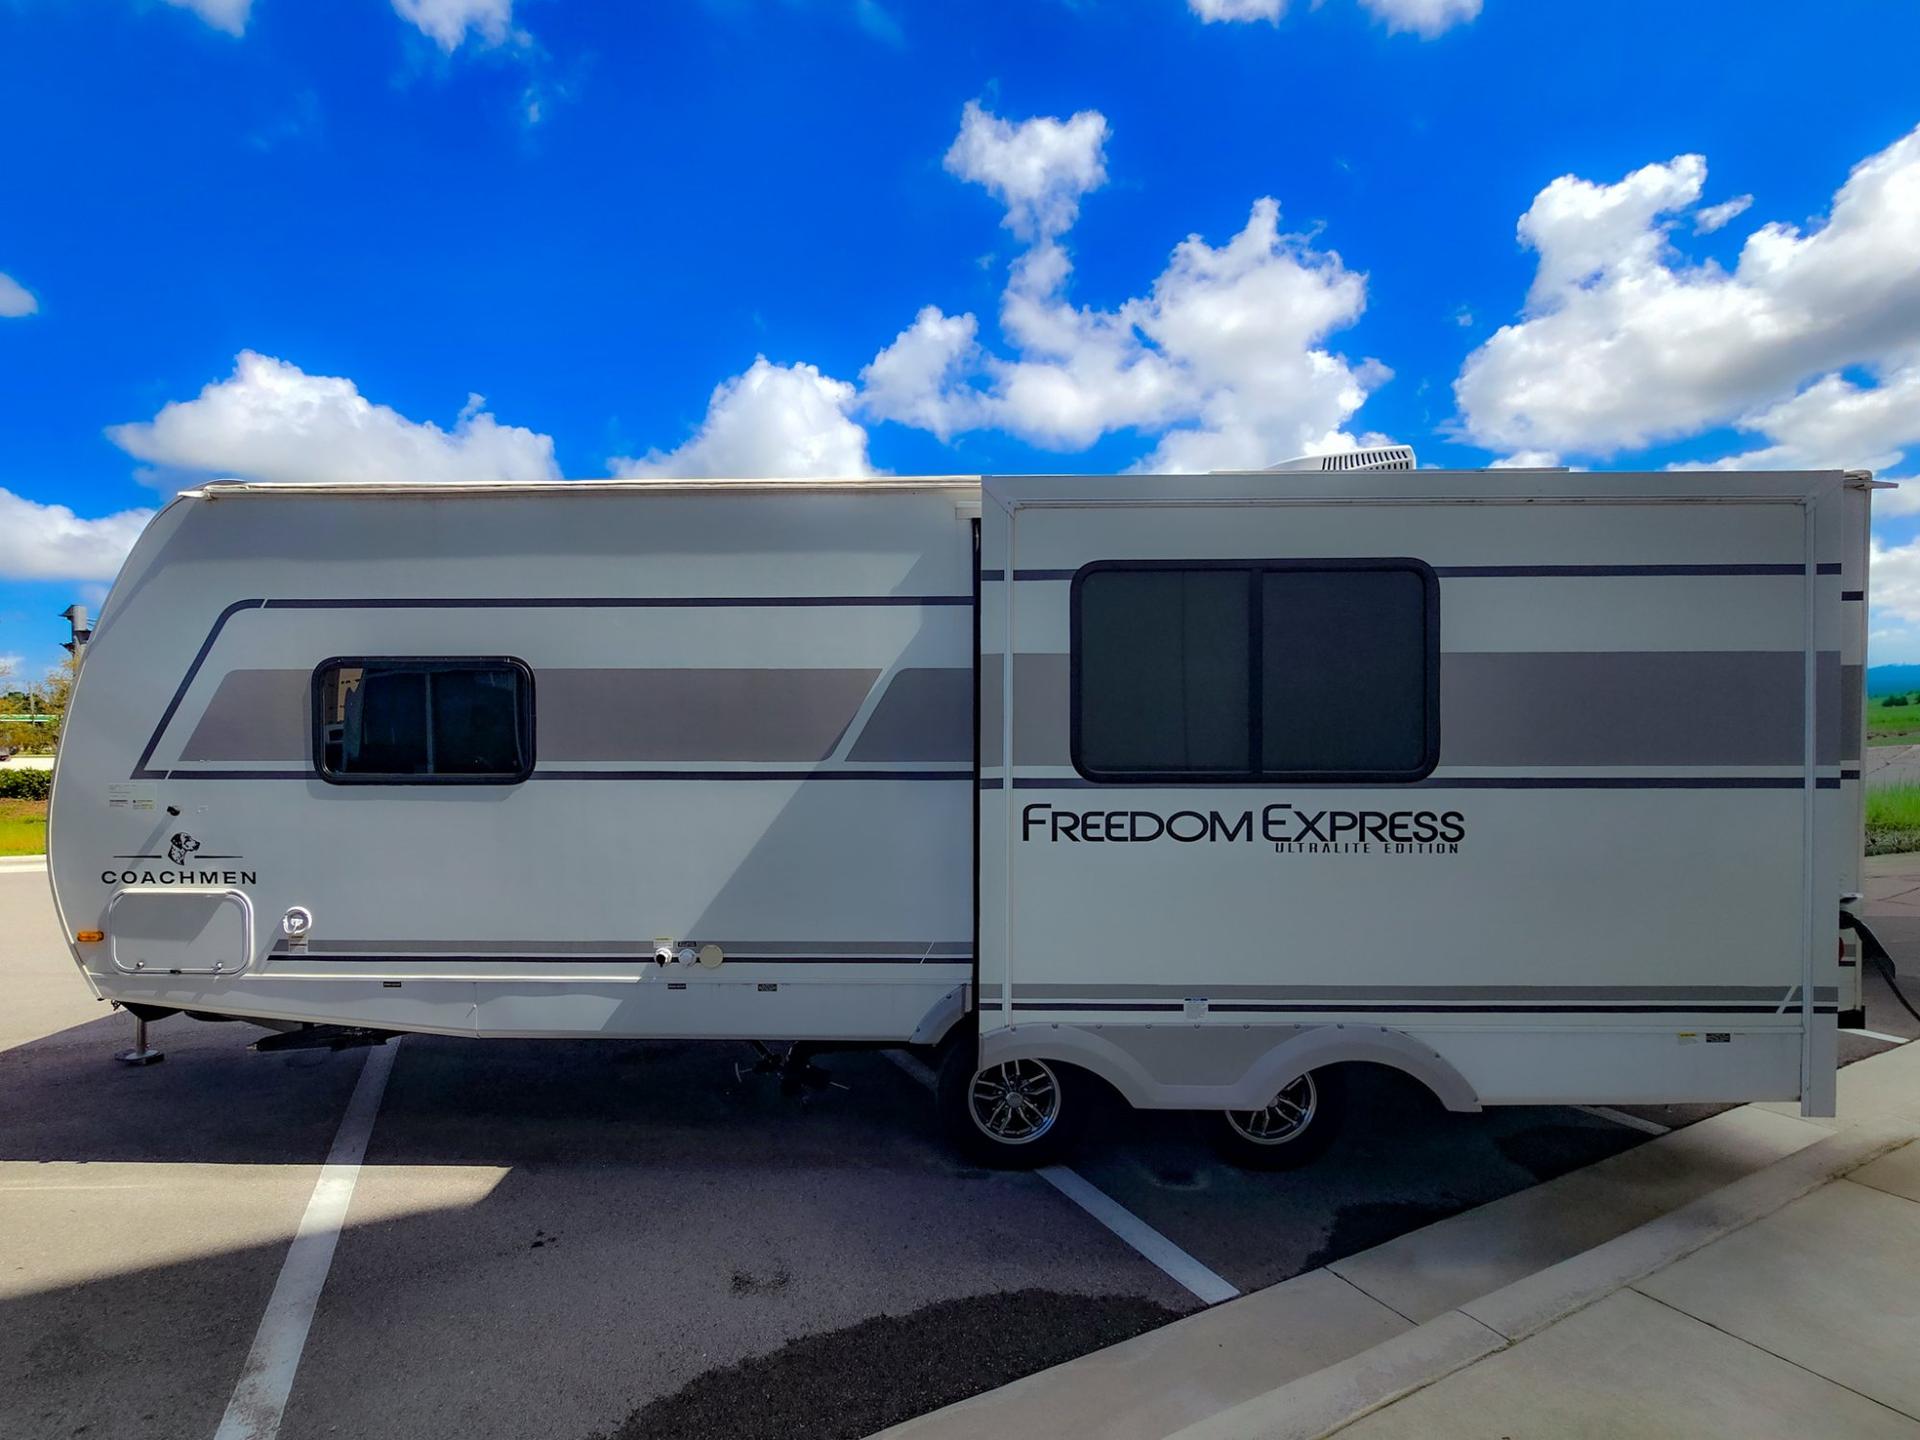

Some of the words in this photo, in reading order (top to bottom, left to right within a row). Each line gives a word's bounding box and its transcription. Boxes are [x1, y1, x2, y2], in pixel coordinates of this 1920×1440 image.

[1022, 803, 1253, 842] FREEDOM
[1262, 803, 1465, 842] EXPRESS
[1275, 842, 1370, 854] ULTRALITE
[1384, 842, 1459, 854] EDITION
[101, 870, 257, 885] COACHMEN
